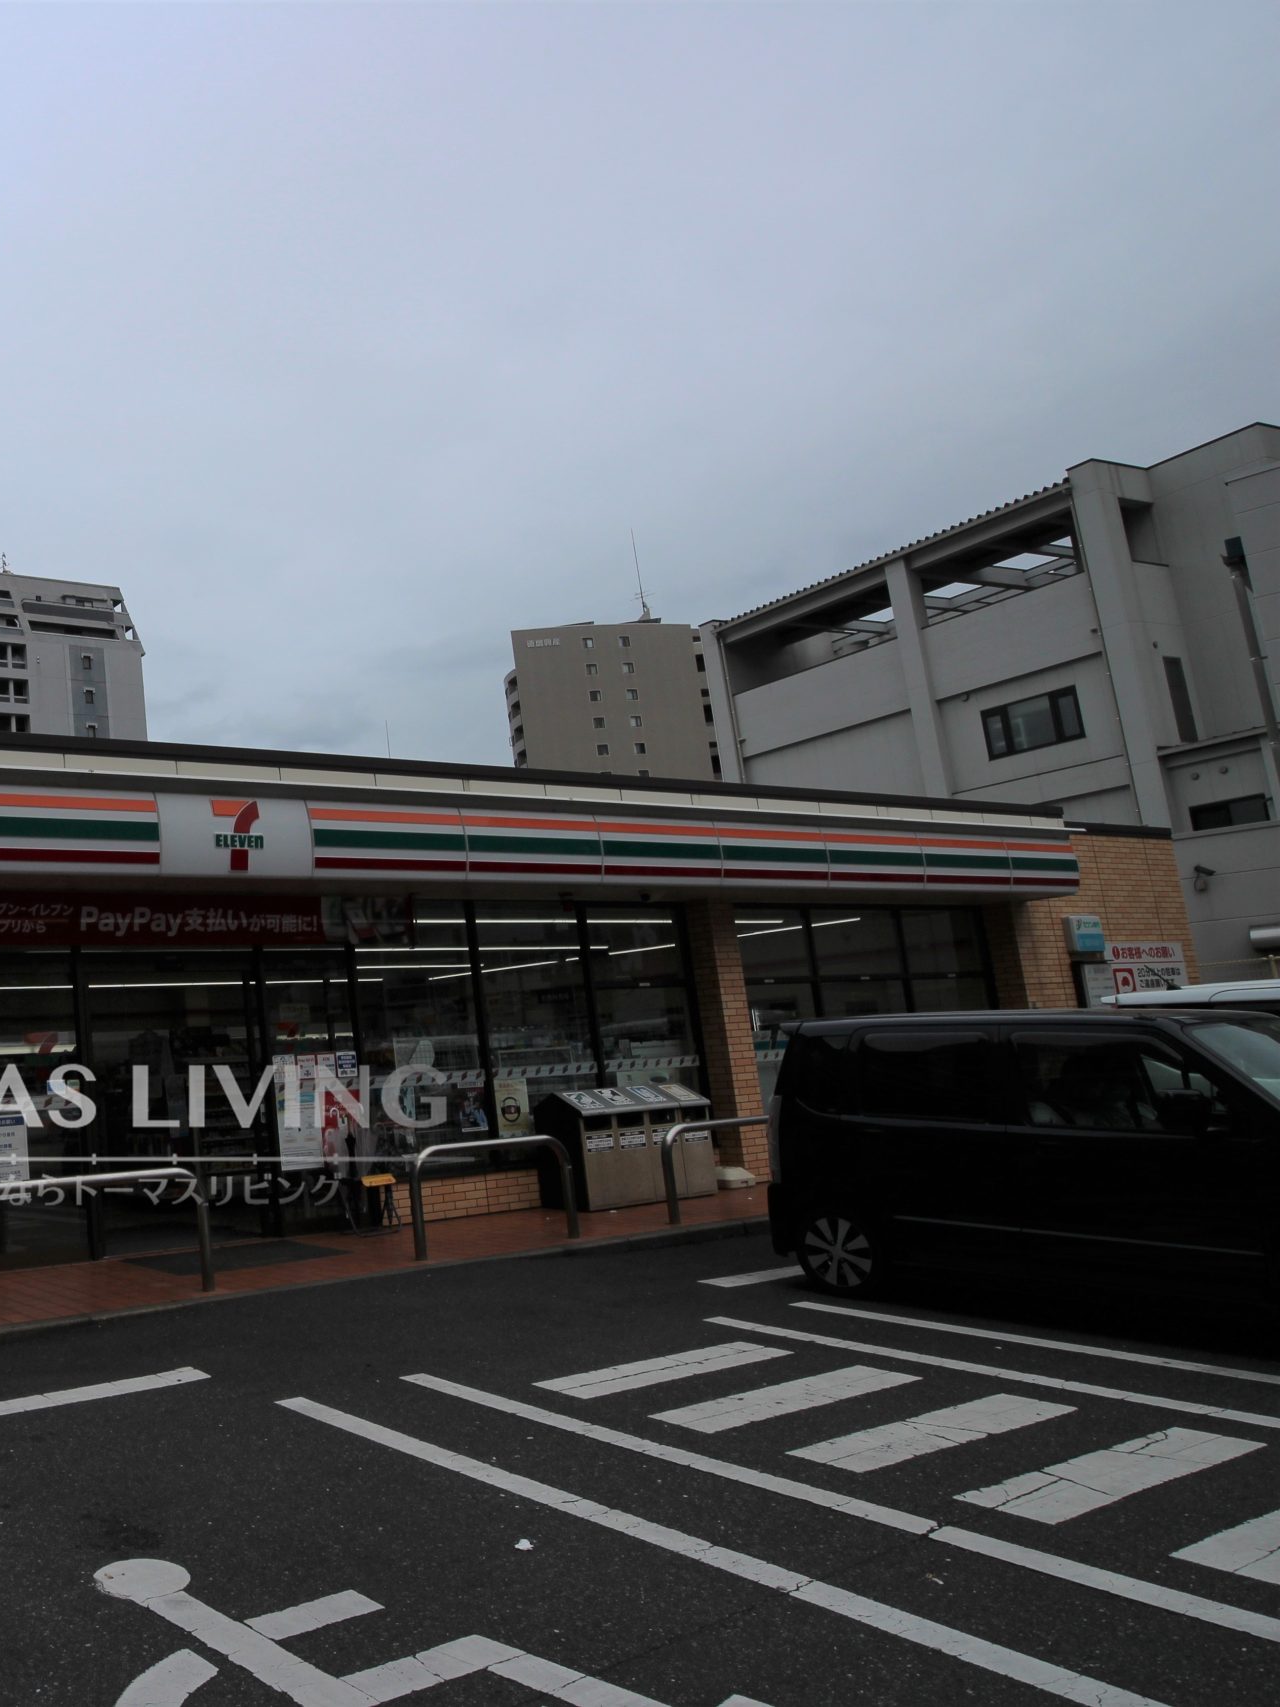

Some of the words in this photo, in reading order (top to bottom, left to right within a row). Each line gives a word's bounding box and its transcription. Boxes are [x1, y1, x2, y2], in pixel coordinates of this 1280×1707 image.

[1121, 945, 1176, 959] お客様へのお願い
